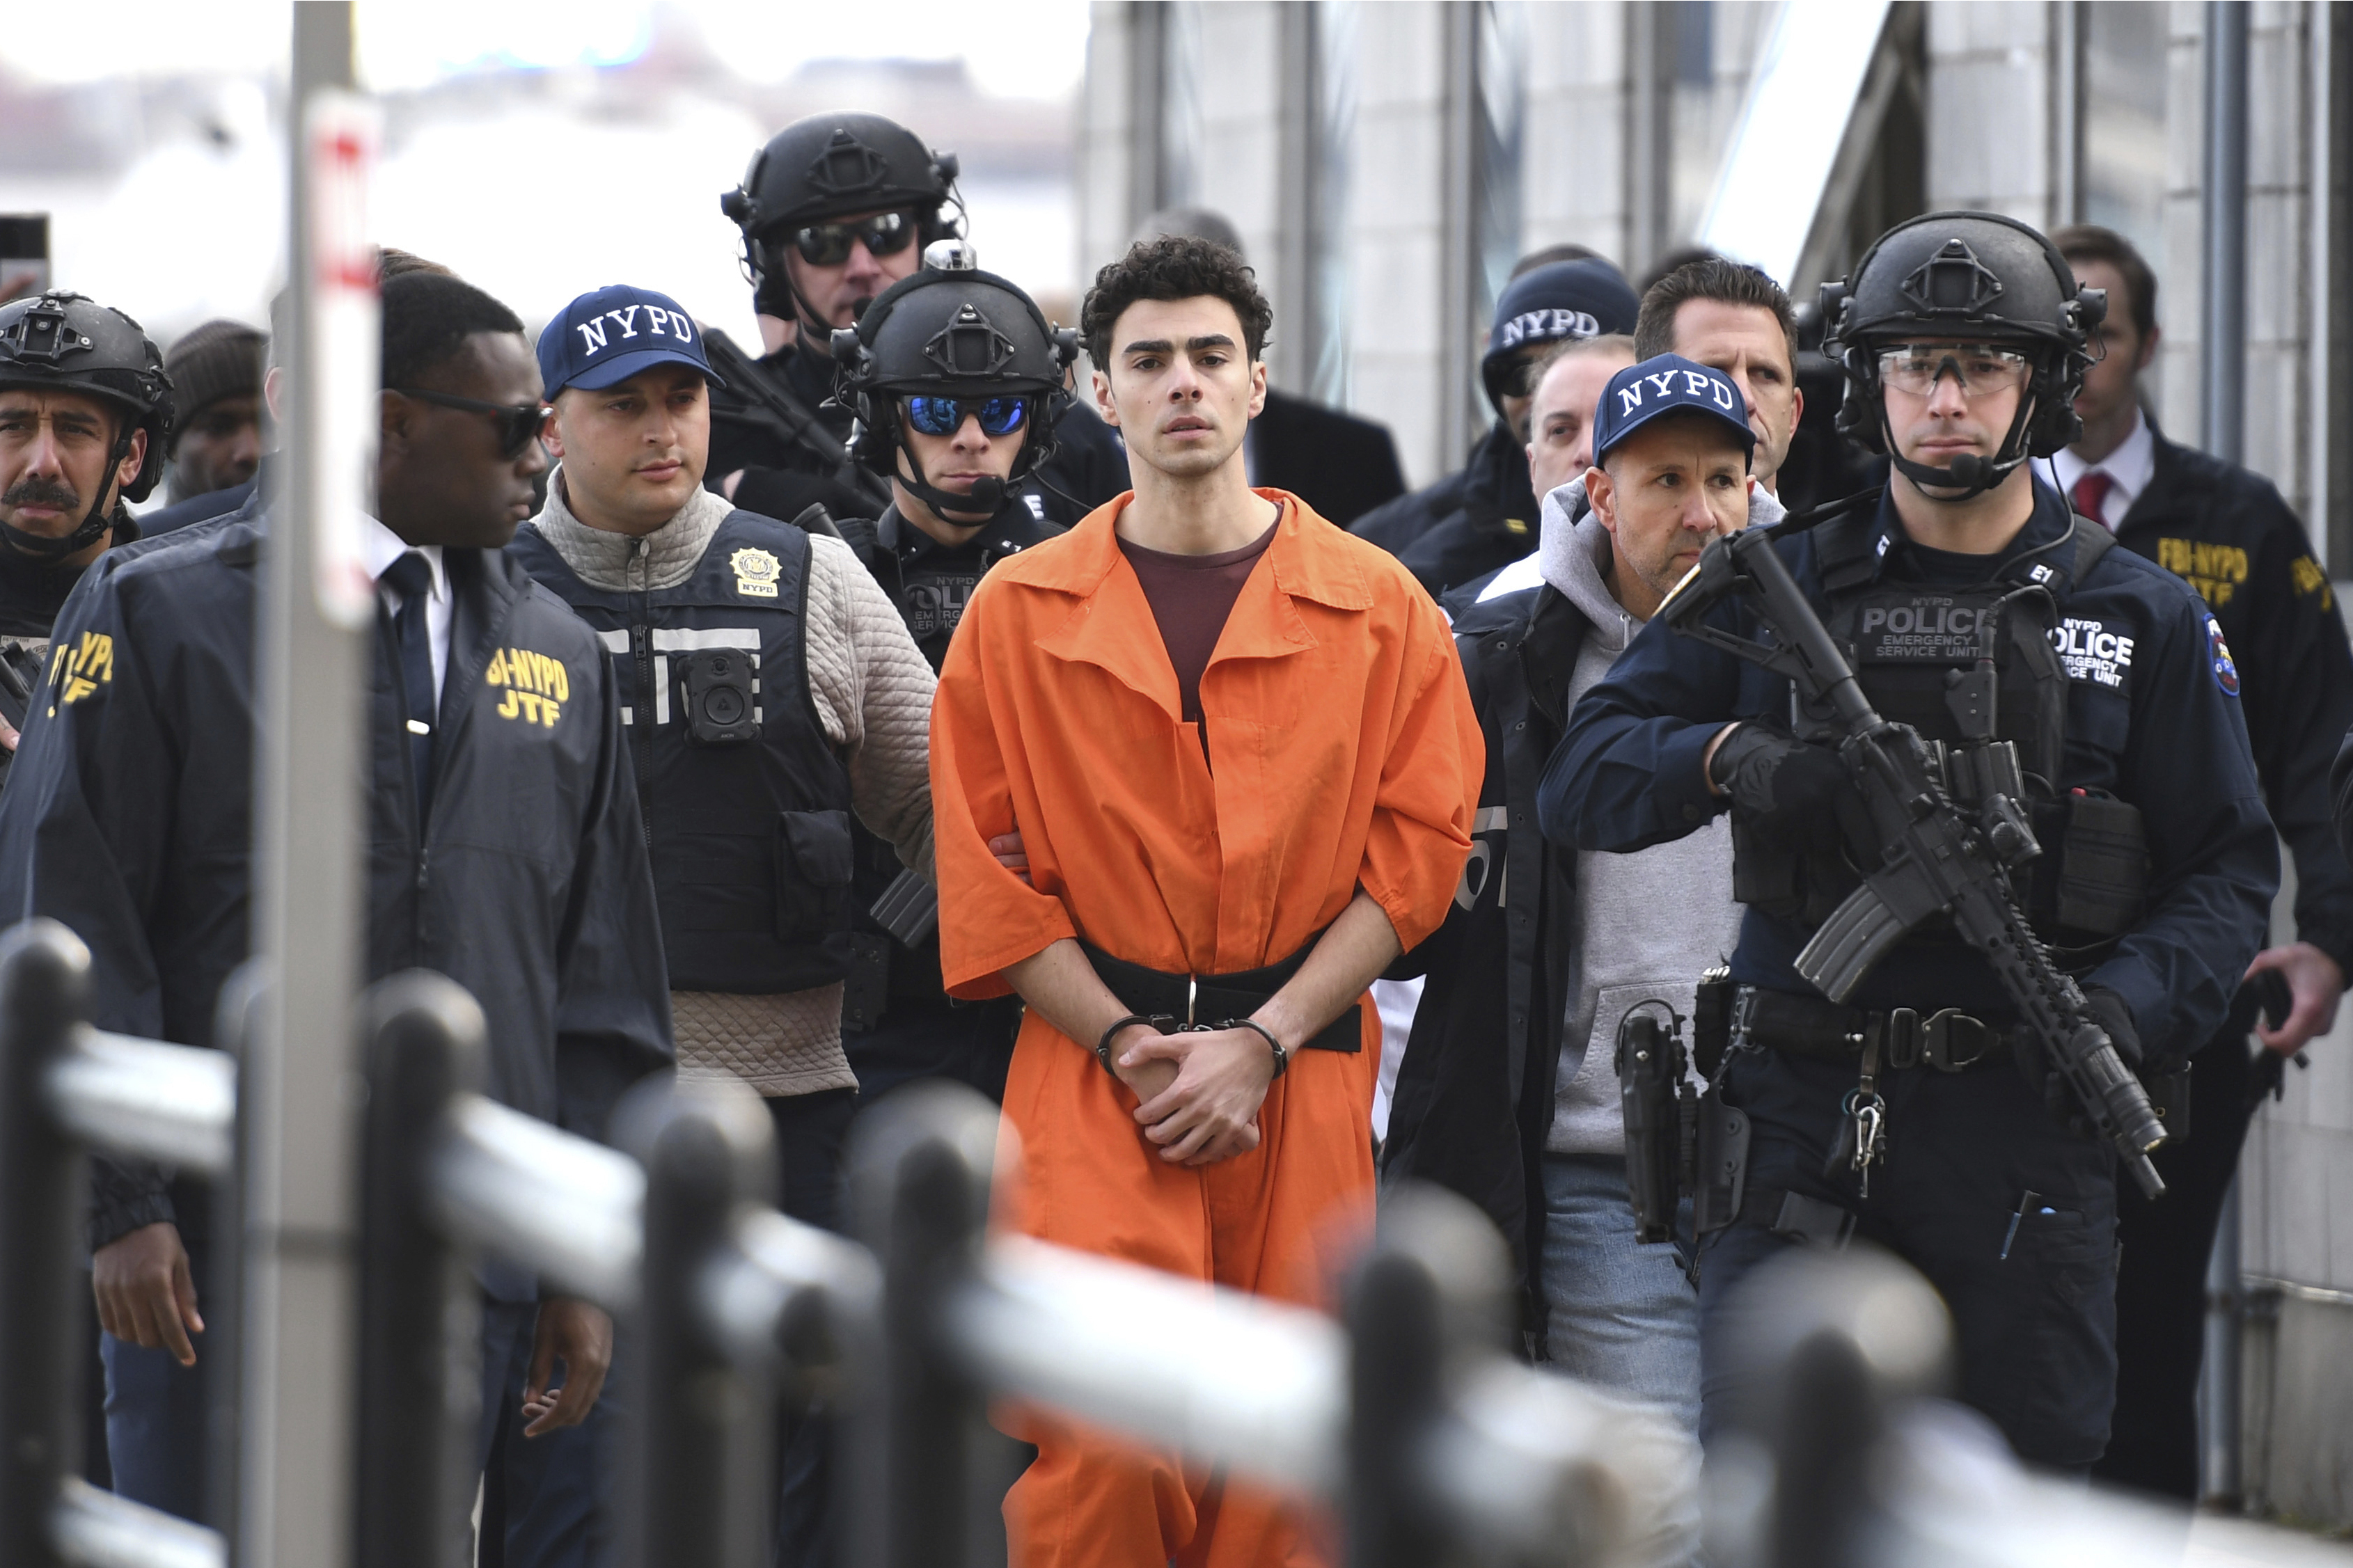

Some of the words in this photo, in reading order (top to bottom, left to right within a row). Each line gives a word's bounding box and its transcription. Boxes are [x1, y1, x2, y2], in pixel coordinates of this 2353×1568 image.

[577, 305, 691, 356] NYPD
[1502, 309, 1600, 347] NYPD
[1618, 370, 1733, 418] NYPD
[936, 576, 974, 585] NYPD
[2029, 564, 2054, 584] E1
[742, 584, 773, 593] NYPD
[1912, 597, 1953, 606] NYPD
[2063, 618, 2102, 633] NYPD
[1883, 635, 1973, 646] EMERGENCY
[2046, 626, 2134, 666] OLICE
[1876, 646, 1937, 656] SERVICE
[1946, 646, 1979, 657] UNIT
[2093, 669, 2123, 688] UNIT
[497, 688, 560, 729] JTF
